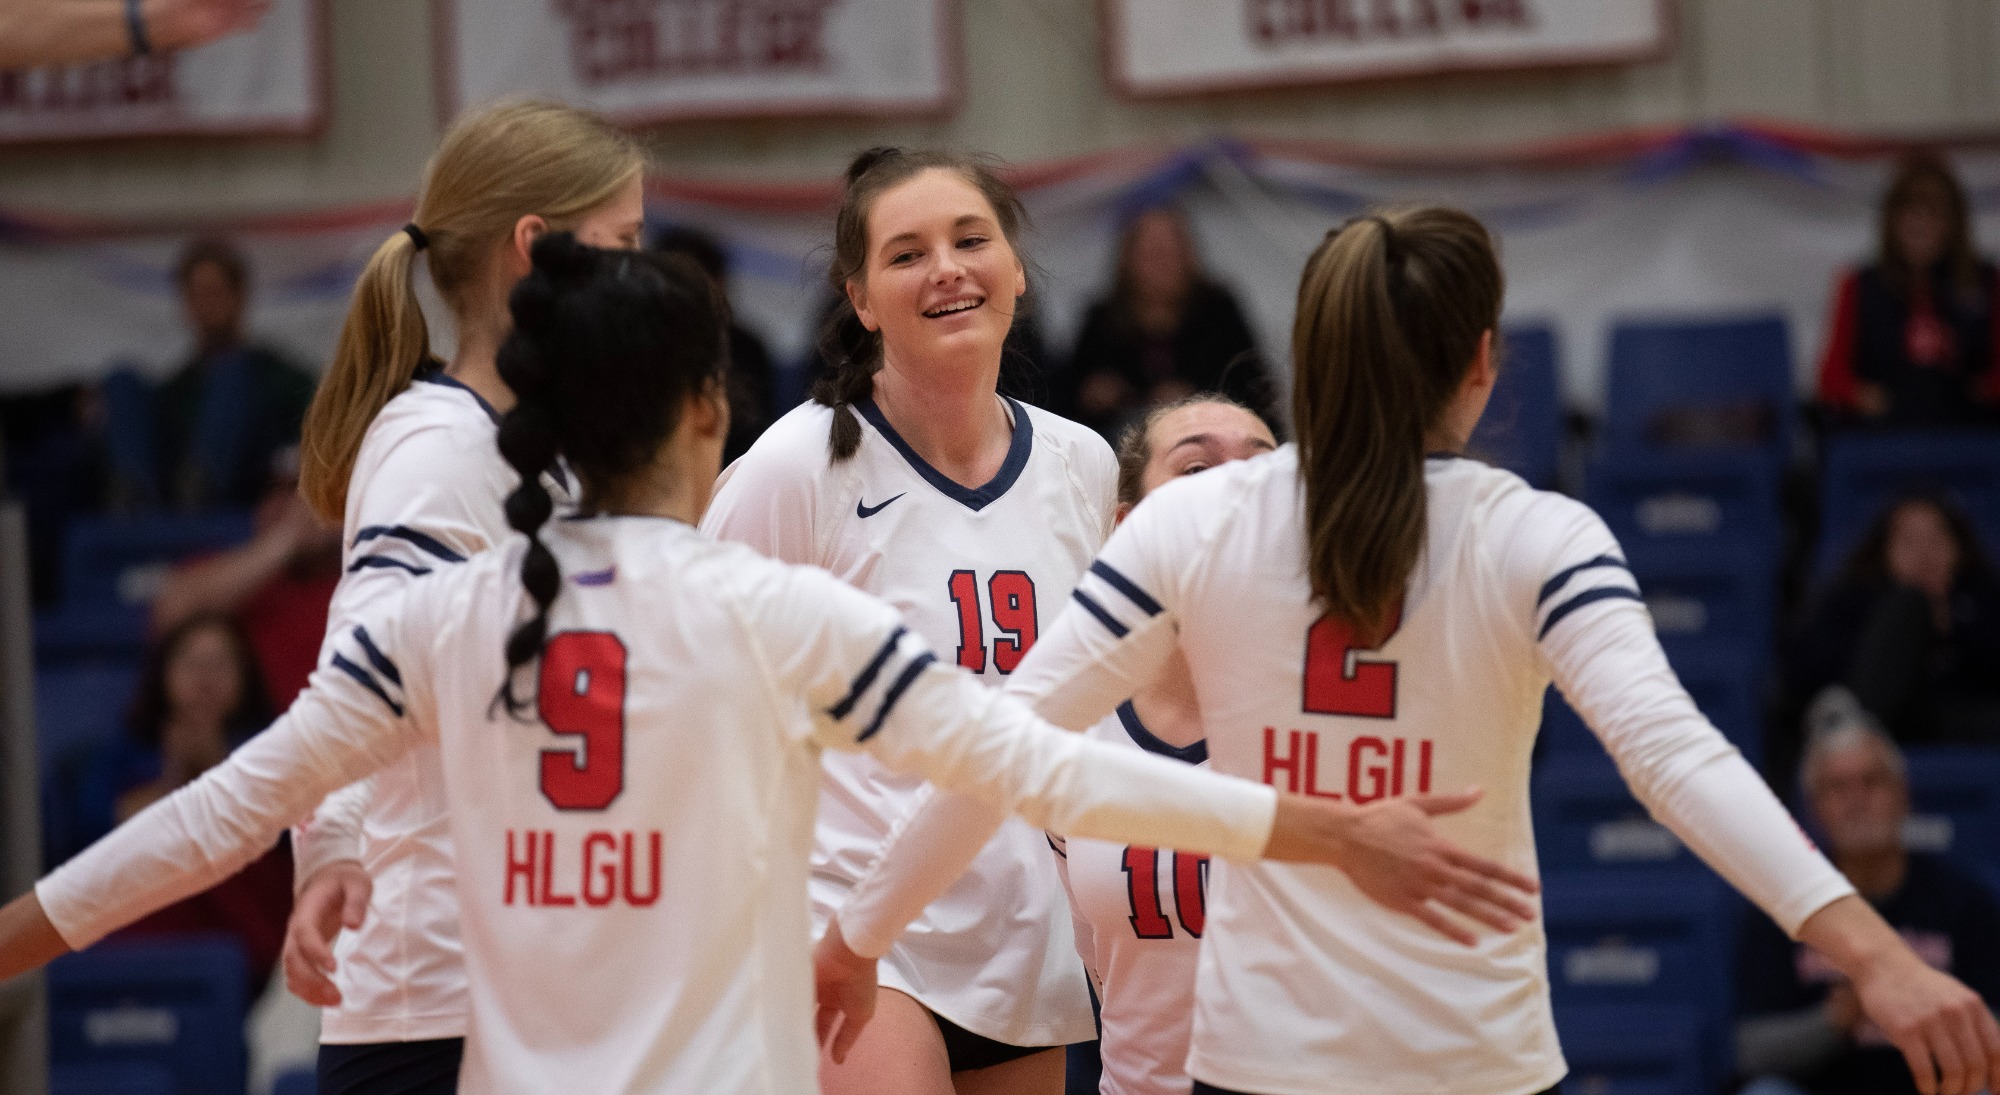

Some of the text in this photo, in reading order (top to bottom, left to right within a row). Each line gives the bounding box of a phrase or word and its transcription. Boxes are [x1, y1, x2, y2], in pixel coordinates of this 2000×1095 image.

[947, 569, 1039, 675] 19
[1302, 595, 1405, 720] 2
[537, 630, 628, 812] 9
[1263, 726, 1434, 804] HLGU
[502, 827, 663, 909] HLGU
